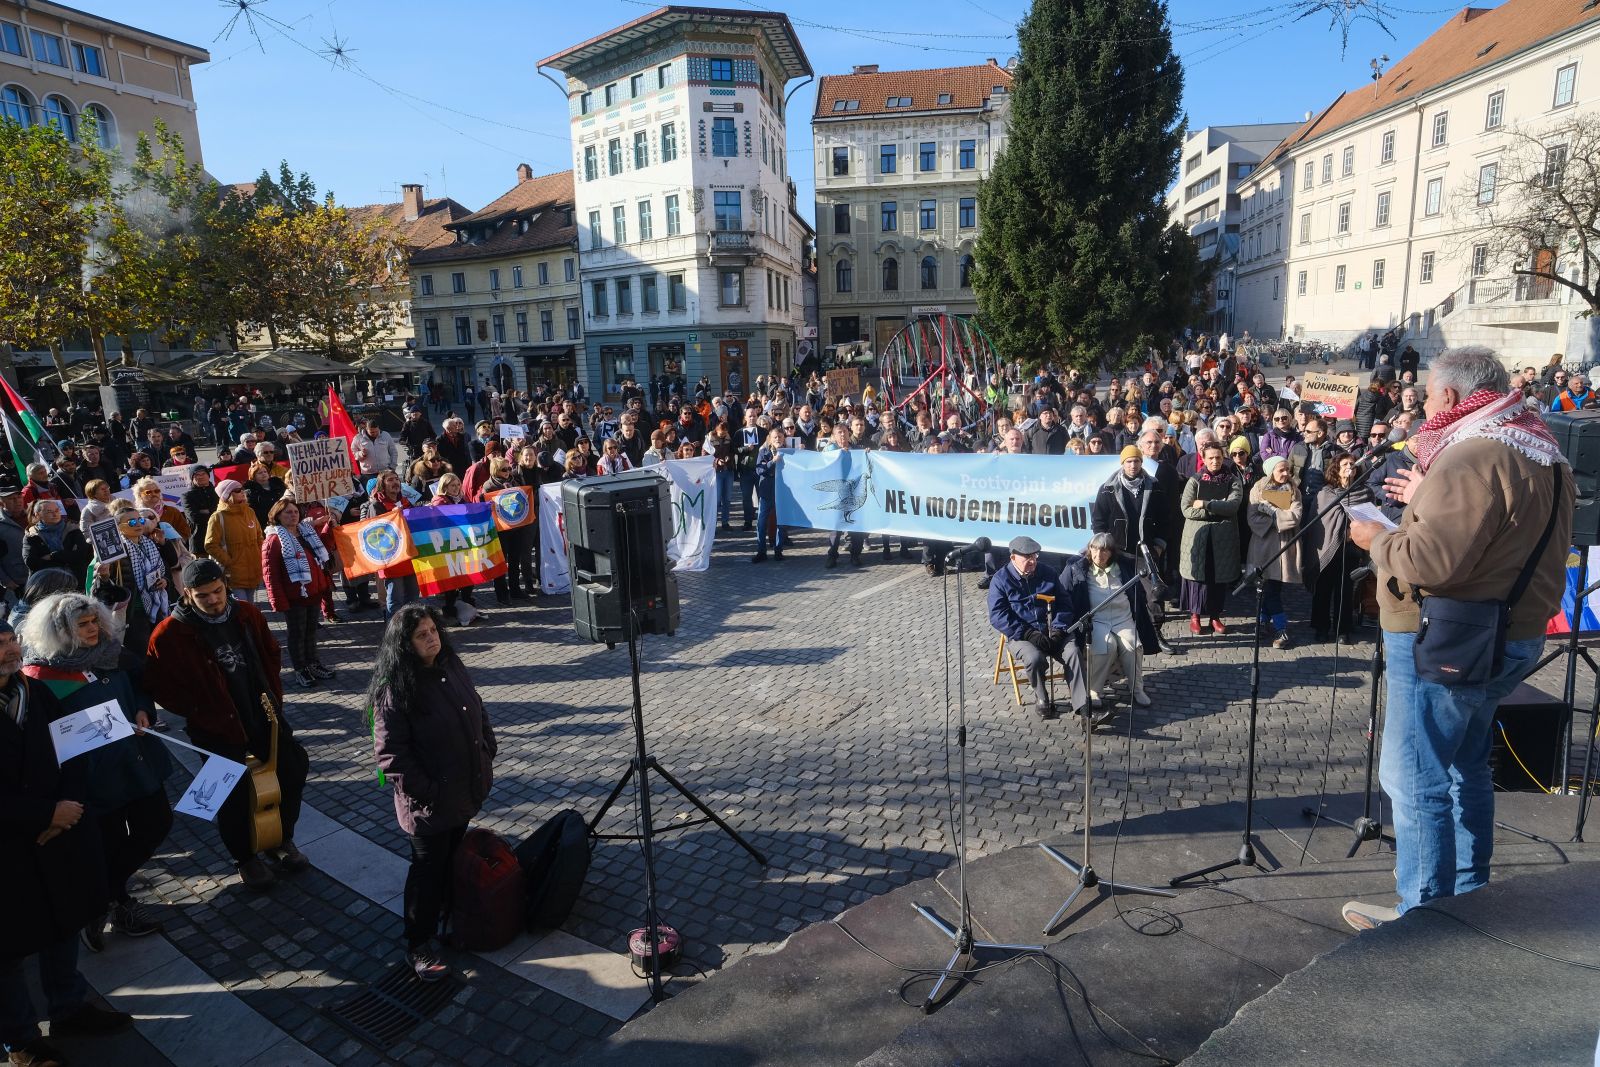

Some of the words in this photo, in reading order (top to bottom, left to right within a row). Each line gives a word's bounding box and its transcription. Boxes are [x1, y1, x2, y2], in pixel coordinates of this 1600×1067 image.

[602, 422, 614, 438] R
[745, 430, 758, 444] M
[334, 439, 344, 452] Z
[294, 454, 345, 476] VOJNAMI
[304, 481, 340, 502] MIR
[960, 474, 1046, 494] Protivojni
[885, 490, 907, 514] NE
[910, 496, 921, 516] v
[926, 494, 1001, 522] mojem
[444, 548, 495, 577] MIR
